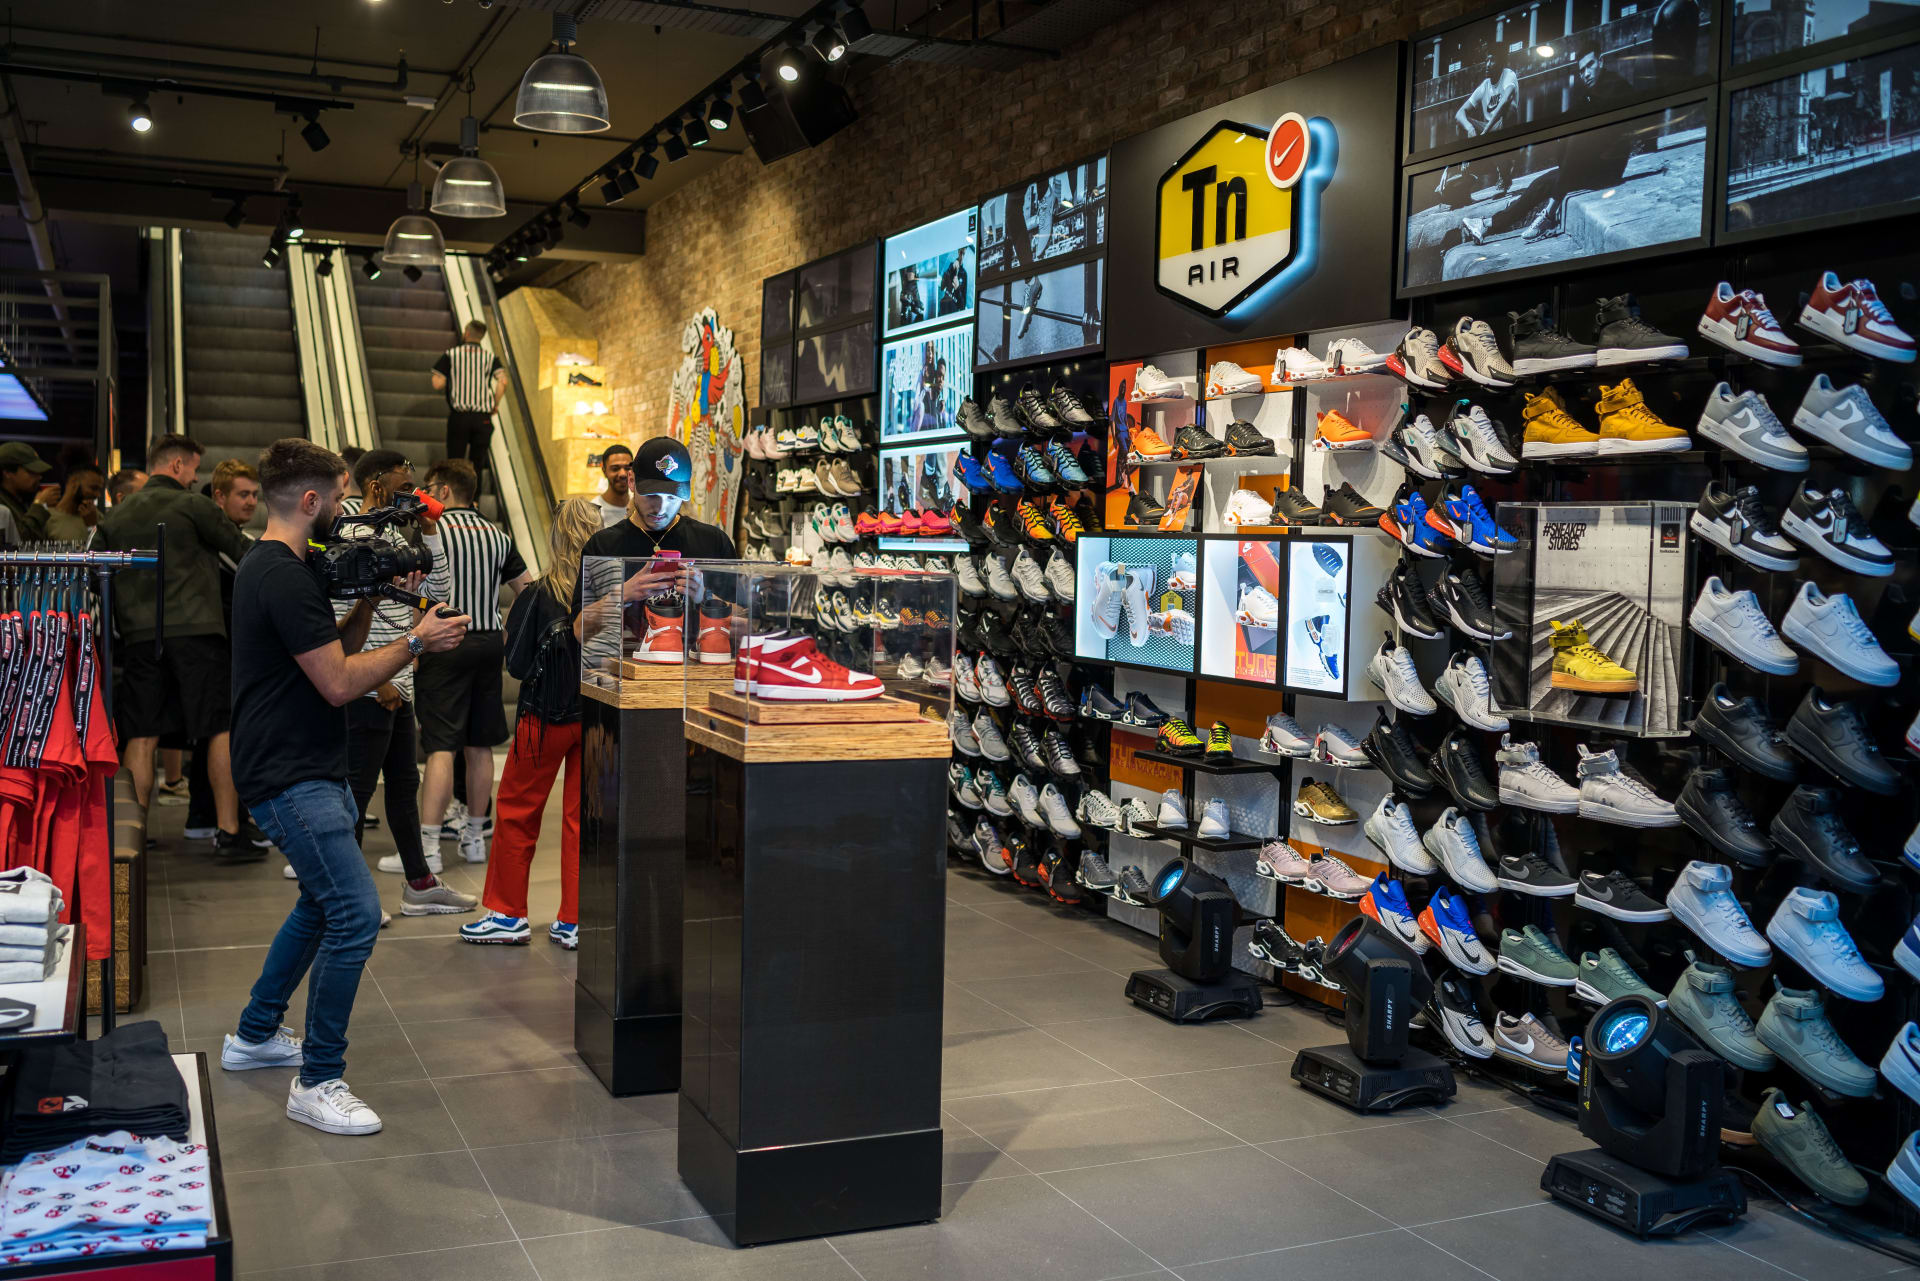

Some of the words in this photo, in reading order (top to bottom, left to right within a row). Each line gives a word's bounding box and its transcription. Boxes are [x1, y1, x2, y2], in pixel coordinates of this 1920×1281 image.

[1182, 165, 1247, 252] Tn
[1187, 256, 1240, 286] AIR
[1542, 522, 1587, 538] #SNEAKER
[1548, 536, 1580, 551] STORIES
[26, 661, 39, 696] Champion
[35, 702, 50, 735] Champion
[76, 697, 84, 731] Champion
[1700, 1100, 1708, 1137] SHARPY
